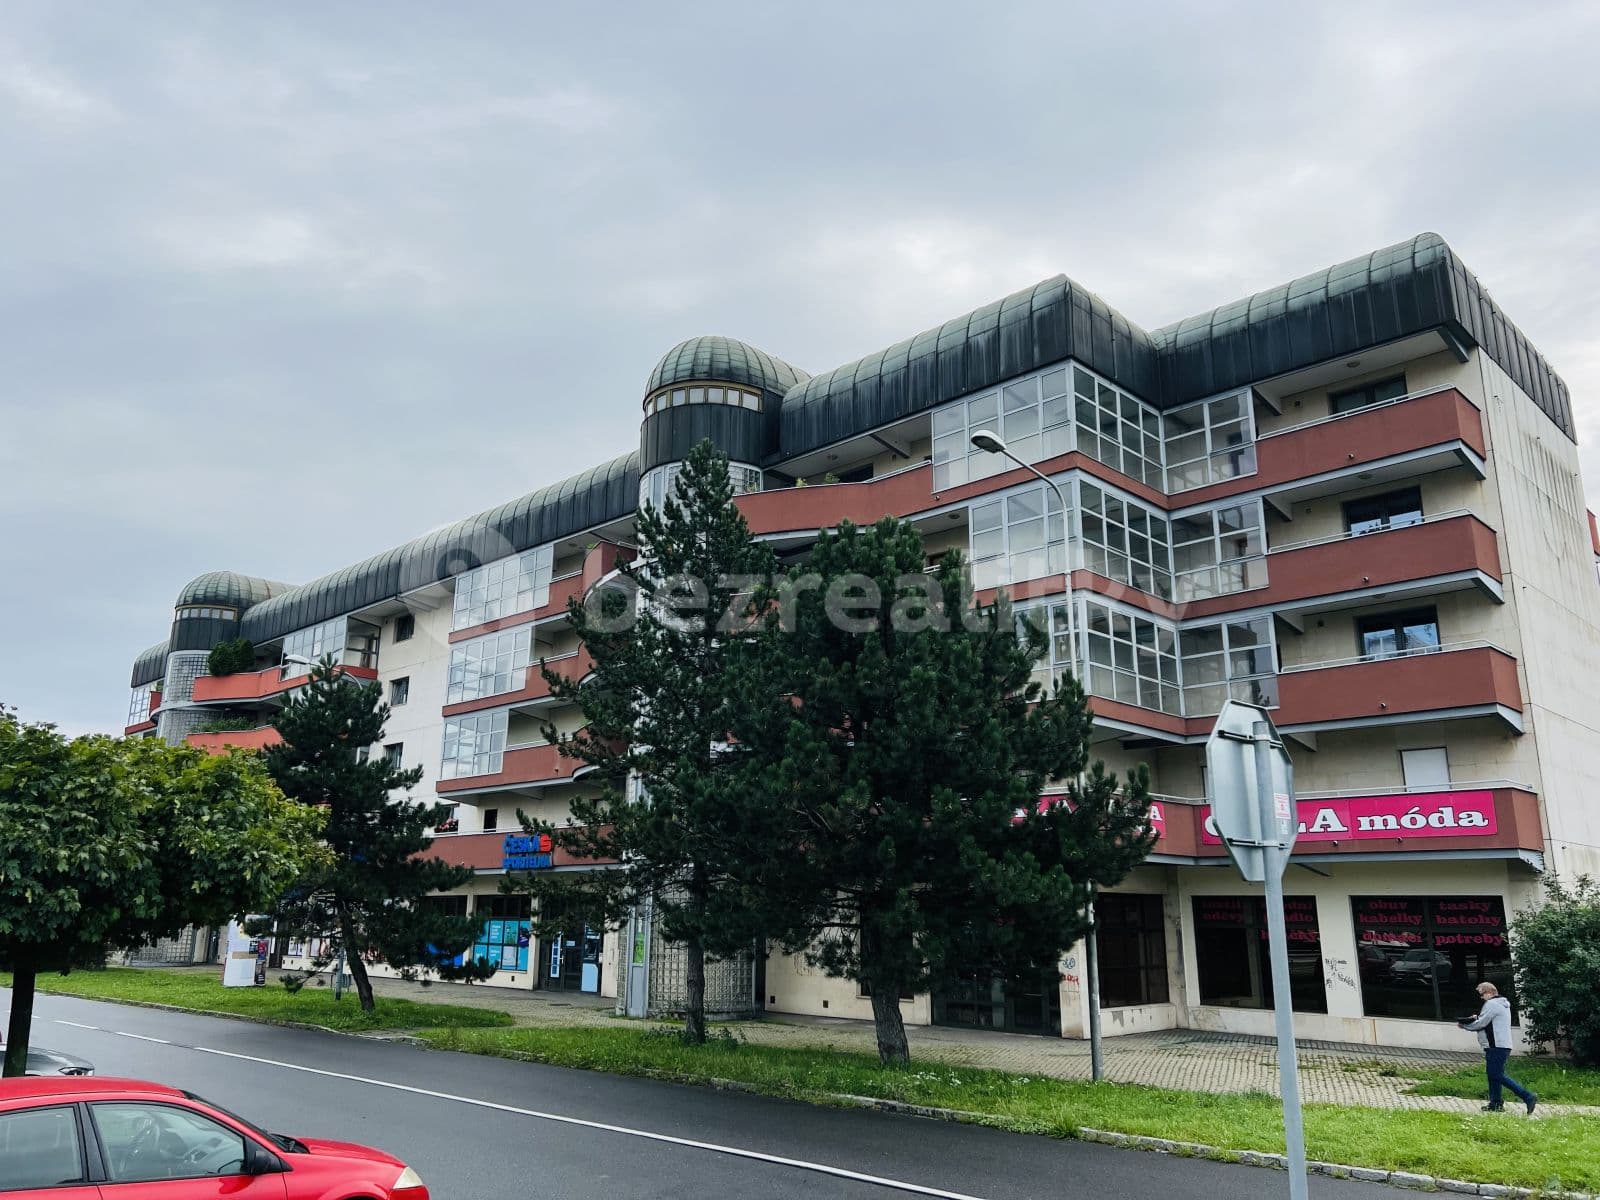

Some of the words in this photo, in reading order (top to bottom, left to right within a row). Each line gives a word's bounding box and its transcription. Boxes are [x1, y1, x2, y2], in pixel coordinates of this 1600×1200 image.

[1357, 806, 1489, 832] móda
[1369, 900, 1408, 910] obuv
[1359, 912, 1423, 925] kabelky
[1435, 914, 1501, 926] batohy
